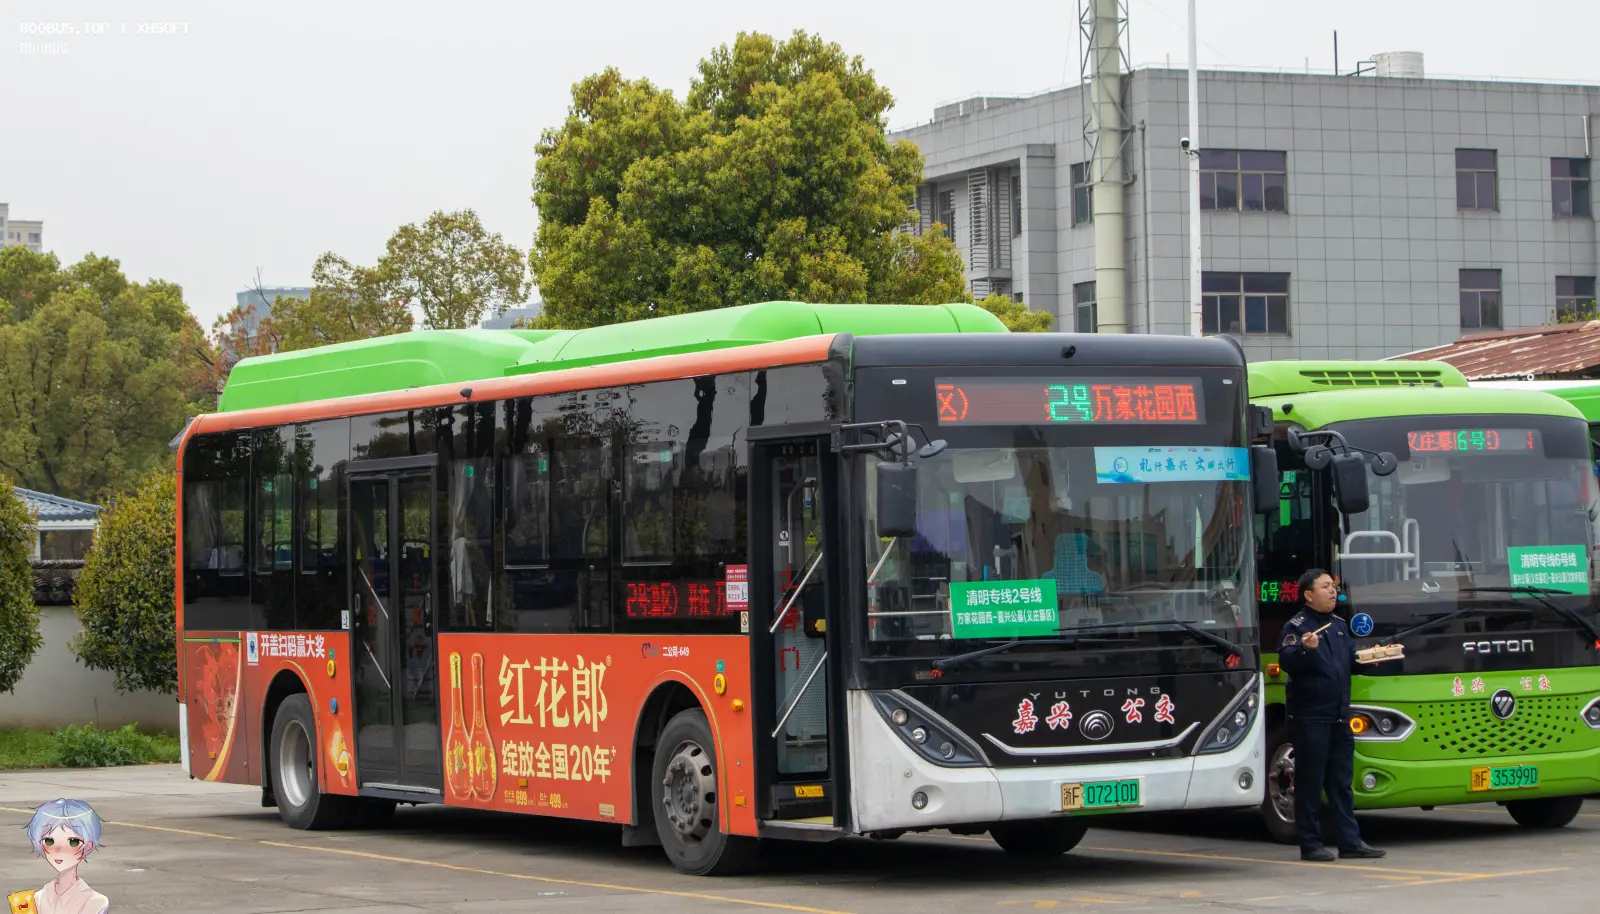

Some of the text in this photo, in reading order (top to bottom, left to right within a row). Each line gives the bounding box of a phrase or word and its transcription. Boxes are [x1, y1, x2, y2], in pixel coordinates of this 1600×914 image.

[1520, 551, 1578, 569] 清明专线6号线
[966, 586, 1043, 606] 清明专线2号线
[261, 633, 325, 659] 开盖扫码赢大奖
[1462, 639, 1534, 654] FOTON
[498, 654, 608, 732] 红花郎
[1029, 686, 1161, 700] YUTONG
[1452, 674, 1552, 696] 嘉兴 公交
[1012, 694, 1175, 734] 嘉兴 公交
[1493, 767, 1538, 787] 35399D
[1063, 782, 1138, 806] 浙F 07210D
